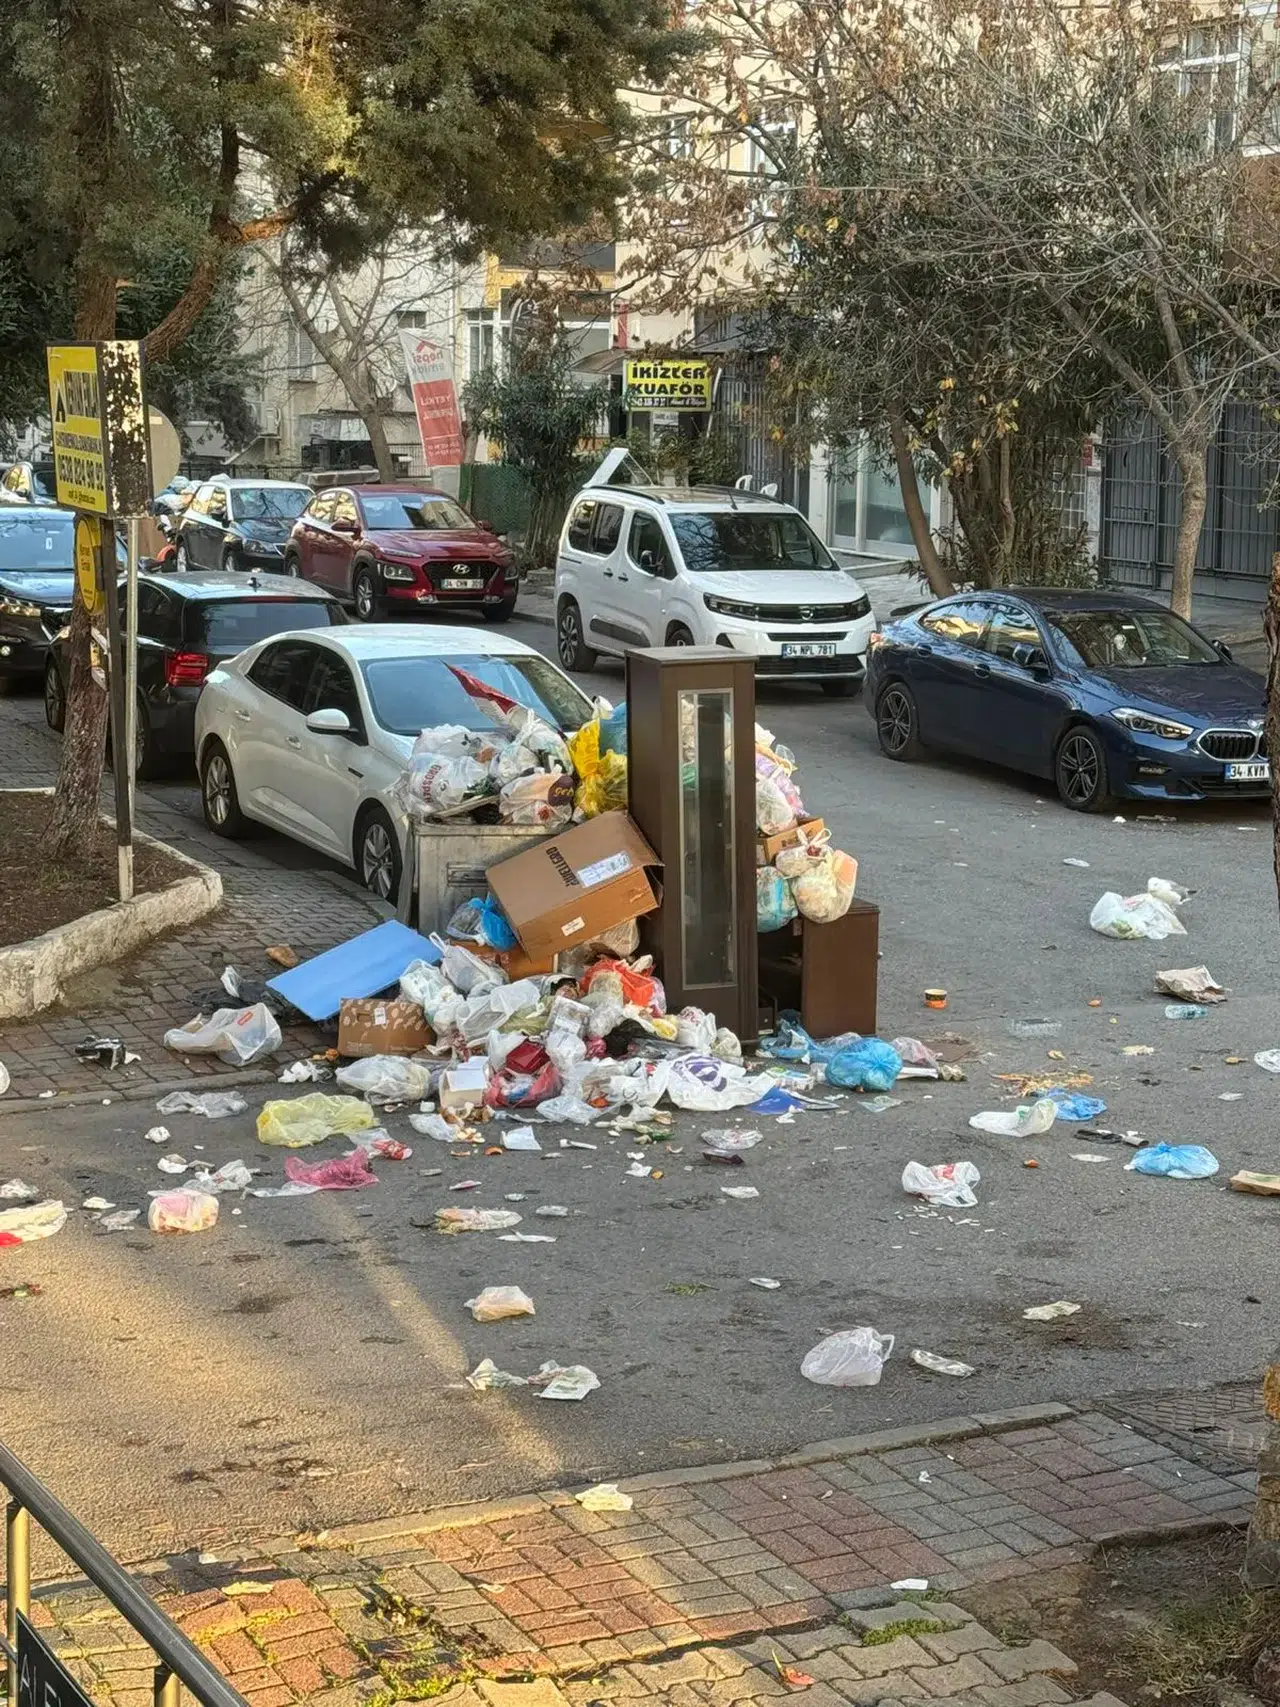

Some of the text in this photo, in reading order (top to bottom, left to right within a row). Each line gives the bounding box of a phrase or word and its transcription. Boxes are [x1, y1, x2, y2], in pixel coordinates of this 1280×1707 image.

[629, 382, 705, 395] KUAFÖR
[787, 645, 797, 655] 34
[818, 645, 832, 655] 781
[1231, 765, 1242, 777] 34
